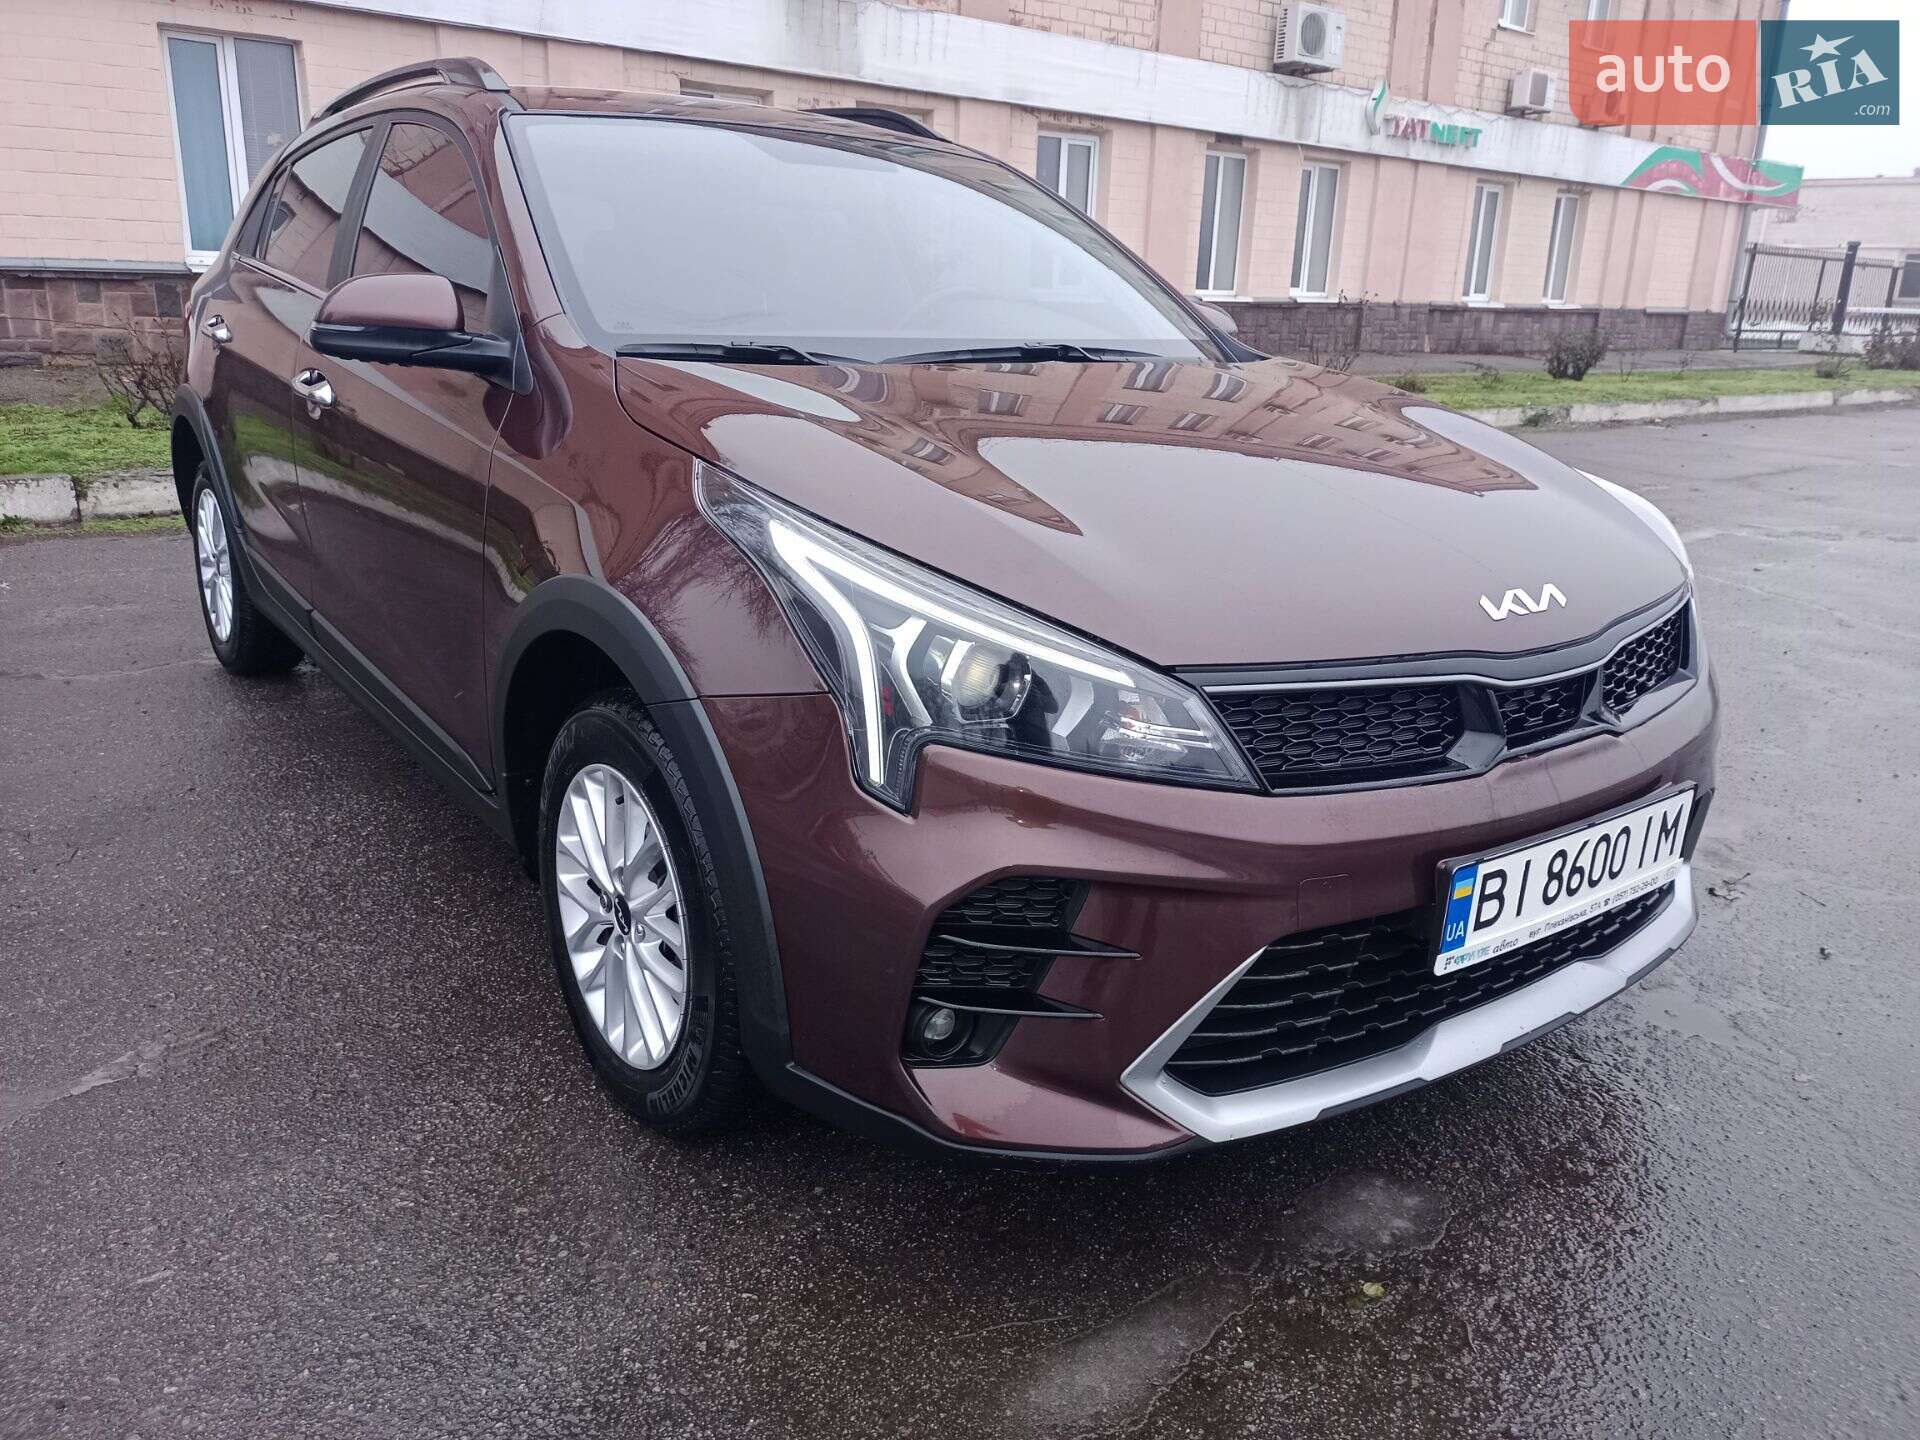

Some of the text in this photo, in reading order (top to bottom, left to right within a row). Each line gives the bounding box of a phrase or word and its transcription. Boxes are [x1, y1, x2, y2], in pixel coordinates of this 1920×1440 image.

[1479, 583, 1567, 621] KIA
[1473, 803, 1684, 932] BI 8600 IM
[1446, 921, 1464, 942] UA
